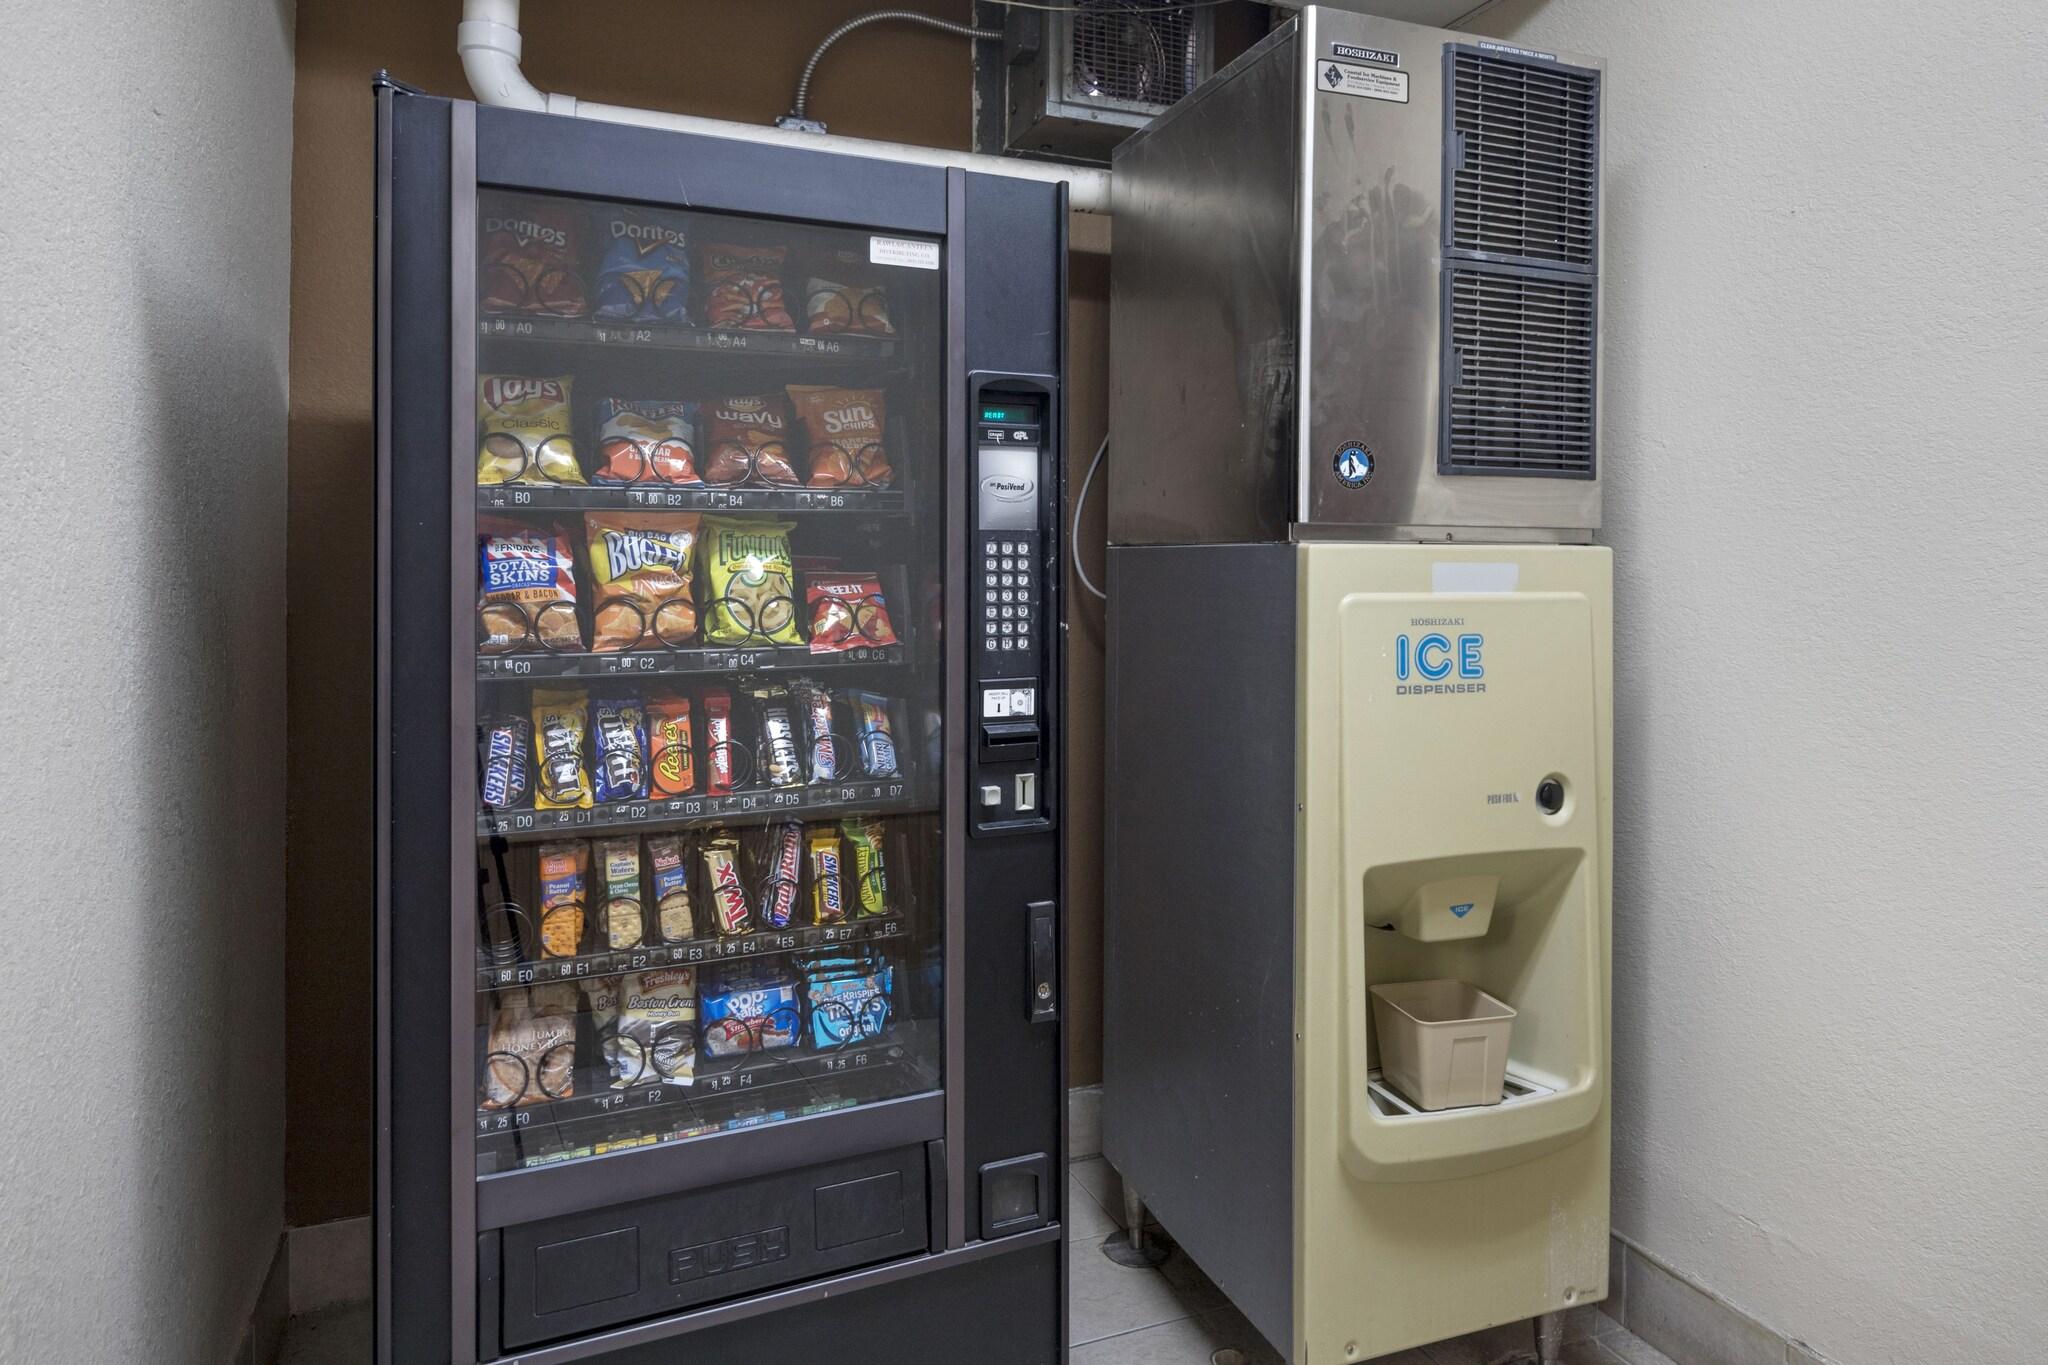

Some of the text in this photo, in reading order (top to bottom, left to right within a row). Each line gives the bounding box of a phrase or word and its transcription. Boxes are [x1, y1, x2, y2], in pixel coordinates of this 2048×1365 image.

[1336, 46, 1395, 63] HOSHIZAKI
[486, 217, 567, 246] Doritos
[610, 220, 687, 247] Doritos
[516, 322, 532, 334] A0
[636, 330, 652, 342] A2
[733, 336, 747, 347] A4
[826, 342, 839, 353] A6
[502, 416, 560, 430] Classic
[823, 405, 874, 433] Sun
[842, 420, 876, 431] CHIPS
[996, 482, 1025, 491] PosiVend
[515, 492, 530, 504] B0
[667, 494, 681, 506] B2
[728, 495, 742, 506] B4
[829, 496, 843, 507] B6
[647, 531, 667, 541] BAG
[604, 530, 687, 581] BUGLES
[489, 560, 550, 574] POTATO
[490, 569, 550, 585] SKINS
[524, 590, 530, 600] &
[533, 589, 559, 599] BACON
[1410, 617, 1465, 627] HOSHIZAKI
[740, 654, 754, 666] C4
[872, 650, 885, 661] C6
[1396, 633, 1484, 681] ICE
[515, 661, 530, 674] C0
[640, 657, 655, 670] C2
[1396, 683, 1487, 695] DISPENSER
[659, 721, 681, 782] Reese's
[875, 742, 886, 769] NUTRI
[881, 742, 895, 773] GRAIN
[484, 730, 512, 804] SNICKERS
[841, 788, 855, 800] D6
[889, 785, 903, 797] D7
[742, 797, 756, 809] D4
[786, 793, 800, 805] D5
[630, 806, 646, 819] D2
[685, 802, 701, 814] D3
[516, 815, 533, 828] D0
[576, 811, 591, 823] D1
[610, 866, 635, 874] Wafers
[824, 855, 840, 910] SNICKERS
[717, 862, 748, 929] TWIX
[1455, 905, 1470, 913] ICE
[840, 928, 852, 940] E7
[885, 922, 897, 934] E6
[743, 941, 755, 954] E4
[781, 936, 794, 948] E5
[689, 949, 704, 961] E3
[632, 955, 647, 968] E2
[576, 963, 590, 975] E1
[518, 970, 534, 982] E0
[645, 970, 690, 988] Freshley's
[842, 987, 881, 1001] KRISPIES
[627, 995, 666, 1009] Boston
[827, 997, 881, 1021] TREATS
[855, 1053, 868, 1066] F6
[740, 1073, 752, 1087] F4
[648, 1089, 662, 1103] F2
[515, 1112, 531, 1125] F0
[671, 1230, 788, 1283] PUSH
